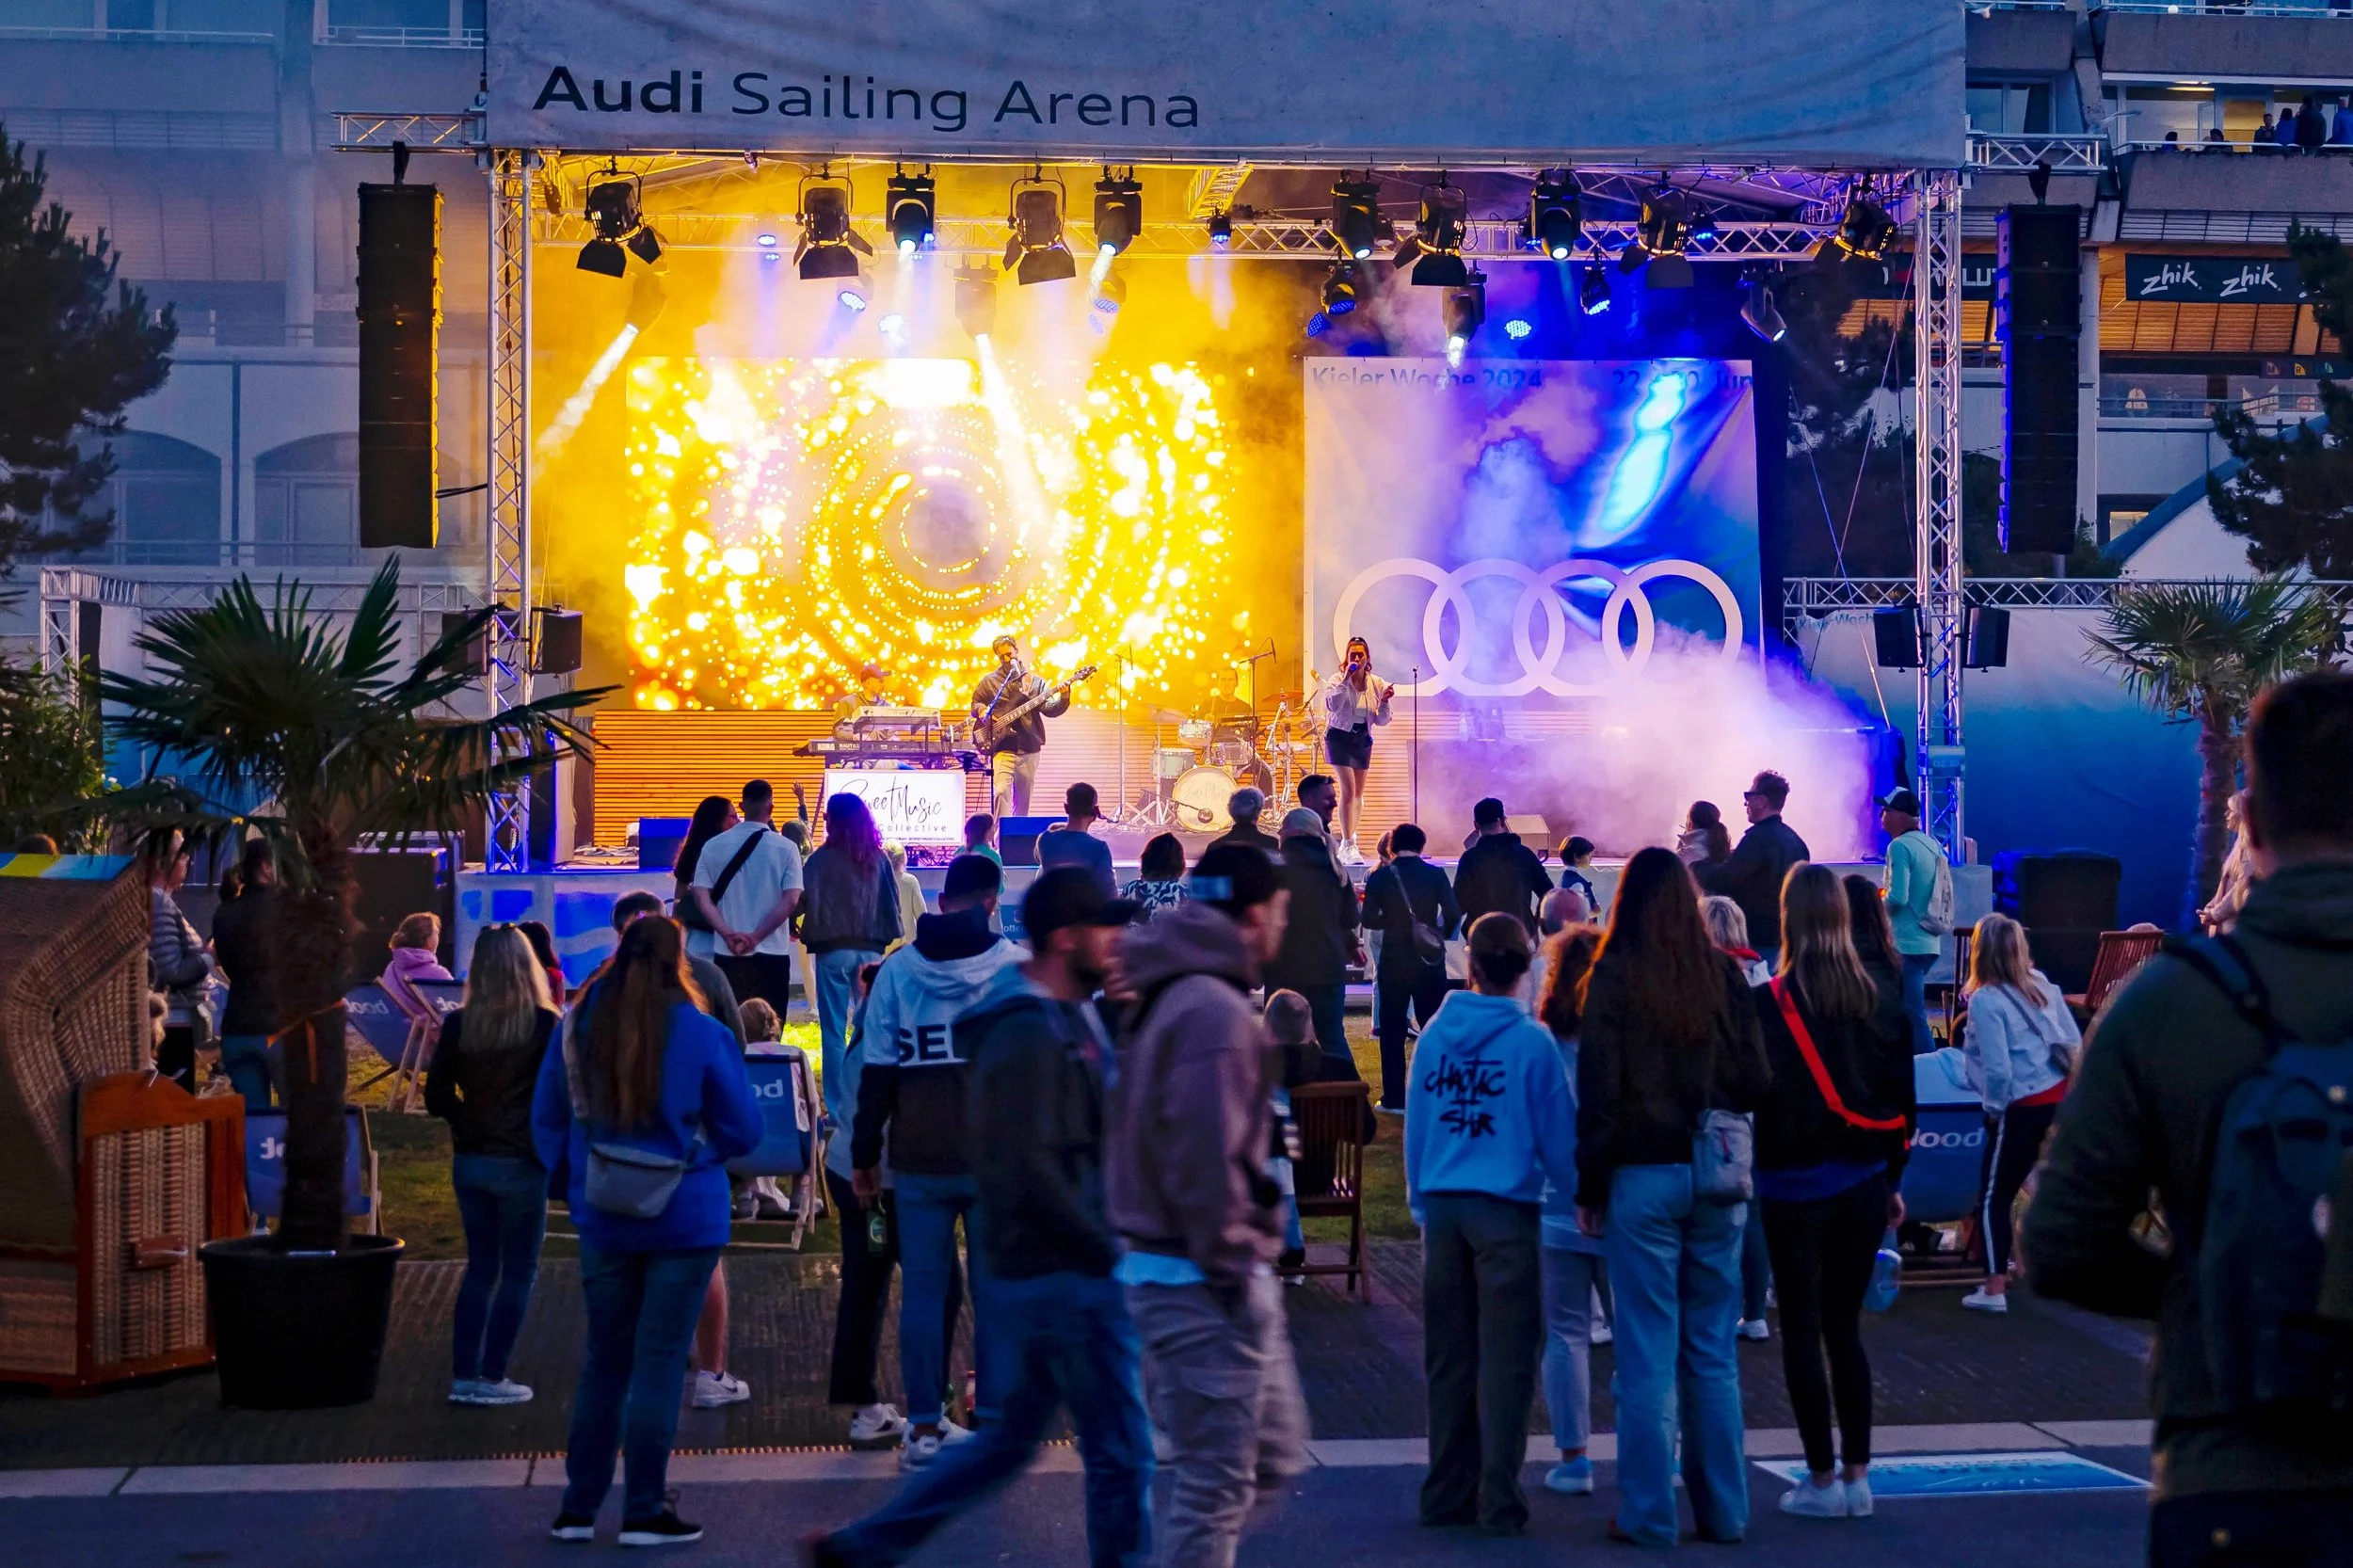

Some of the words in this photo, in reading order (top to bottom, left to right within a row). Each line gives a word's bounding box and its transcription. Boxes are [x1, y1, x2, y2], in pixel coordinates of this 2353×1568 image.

[533, 66, 702, 114] Audi
[731, 72, 968, 132] Sailing
[994, 80, 1198, 128] Arena
[1311, 366, 1385, 388] Kieler
